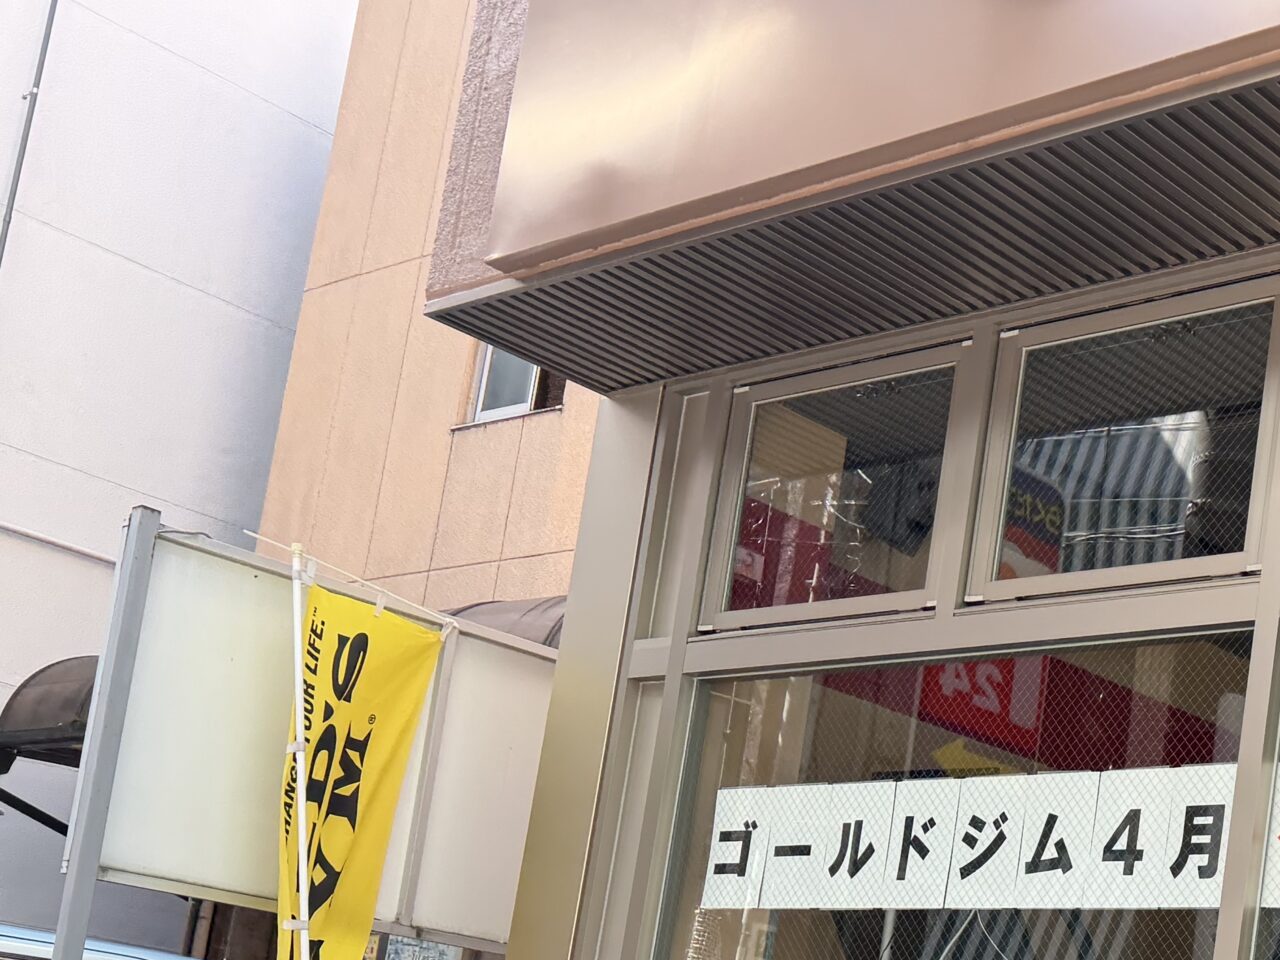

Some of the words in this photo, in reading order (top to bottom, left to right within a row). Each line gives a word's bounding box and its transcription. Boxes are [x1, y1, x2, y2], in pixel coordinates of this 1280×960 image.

[713, 803, 1226, 881] ゴールドジム4月
